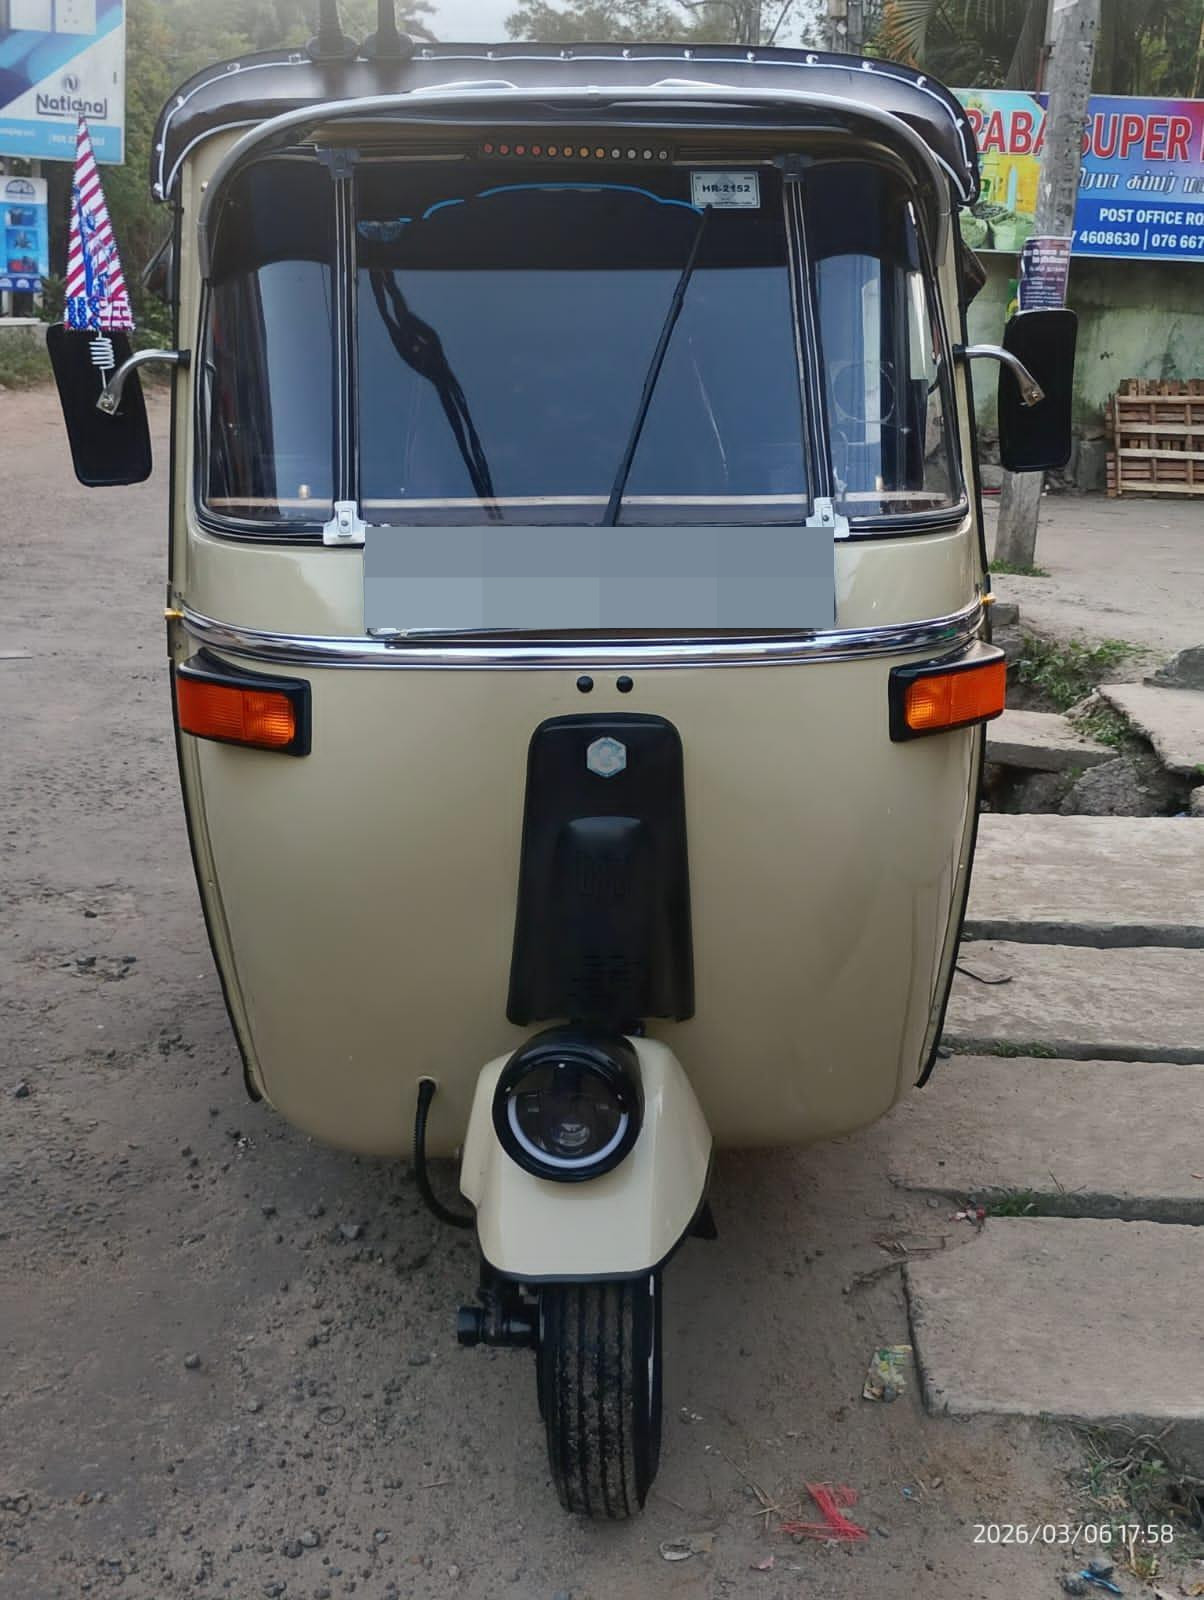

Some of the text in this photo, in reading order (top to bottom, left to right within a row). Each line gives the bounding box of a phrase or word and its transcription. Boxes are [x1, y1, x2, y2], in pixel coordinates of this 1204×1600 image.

[36, 93, 107, 120] National
[966, 109, 1047, 156] RABA
[702, 184, 751, 193] HR-2152
[1100, 208, 1135, 223] POST
[1136, 209, 1183, 225] OFFICE
[1080, 230, 1140, 246] 4608630
[1151, 233, 1177, 248] 076
